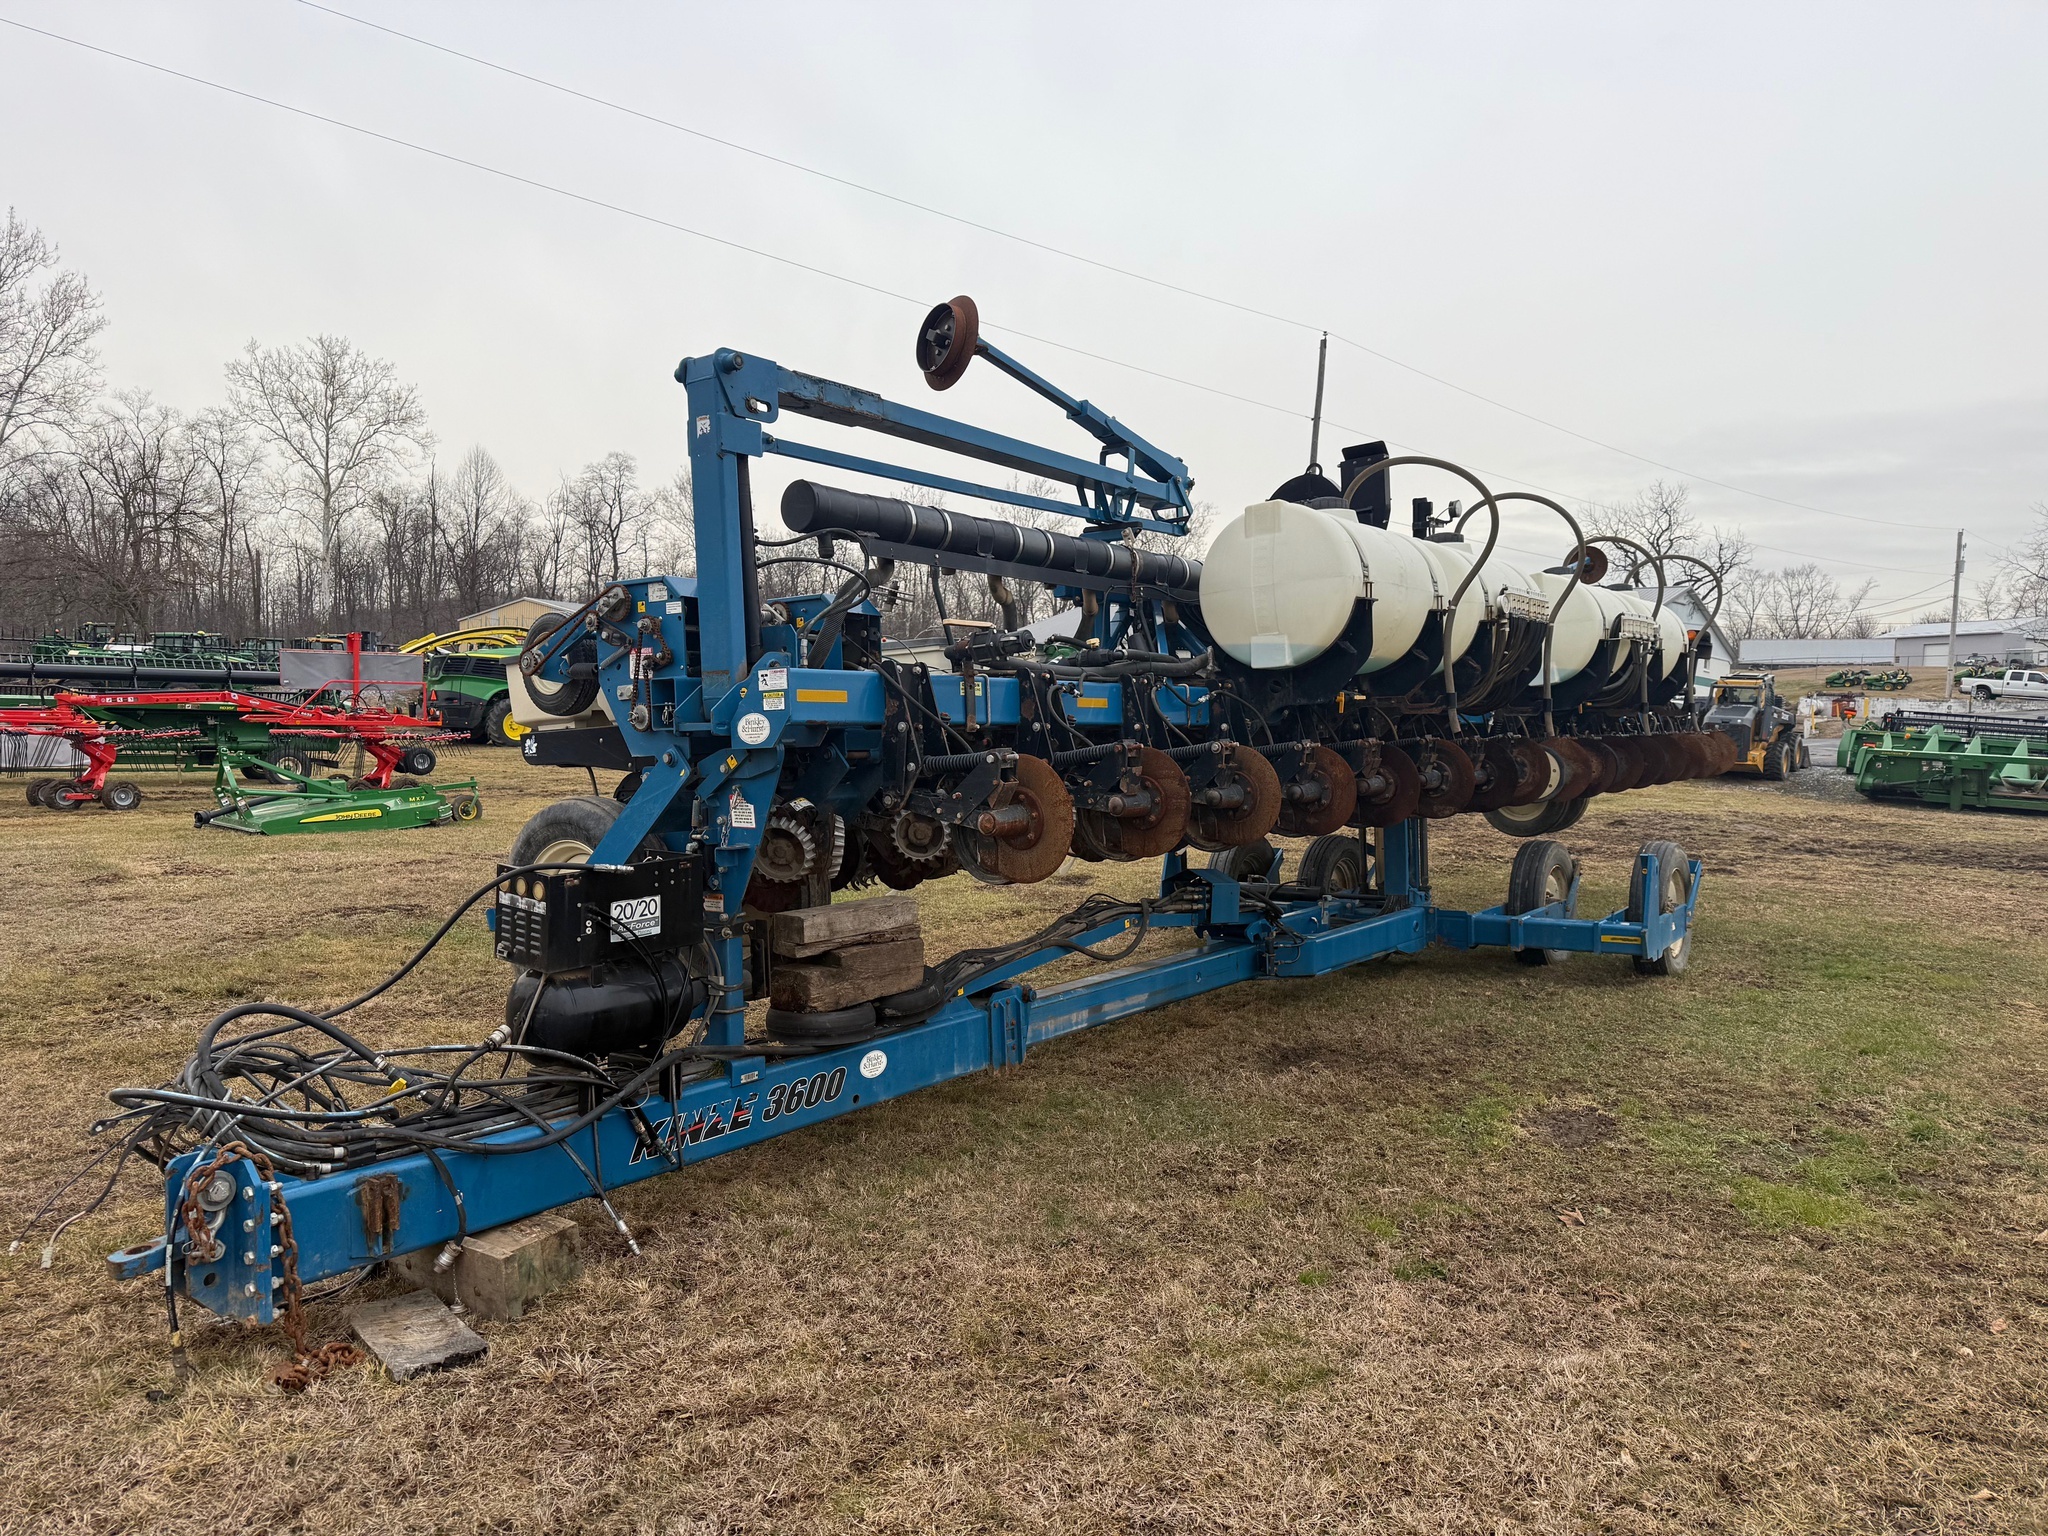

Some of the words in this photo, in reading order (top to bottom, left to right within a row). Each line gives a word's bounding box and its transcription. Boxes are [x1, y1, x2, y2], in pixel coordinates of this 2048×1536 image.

[335, 813, 353, 821] JOHN
[353, 811, 377, 819] DEERE
[614, 898, 658, 921] 20/20
[761, 1066, 848, 1122] 3600
